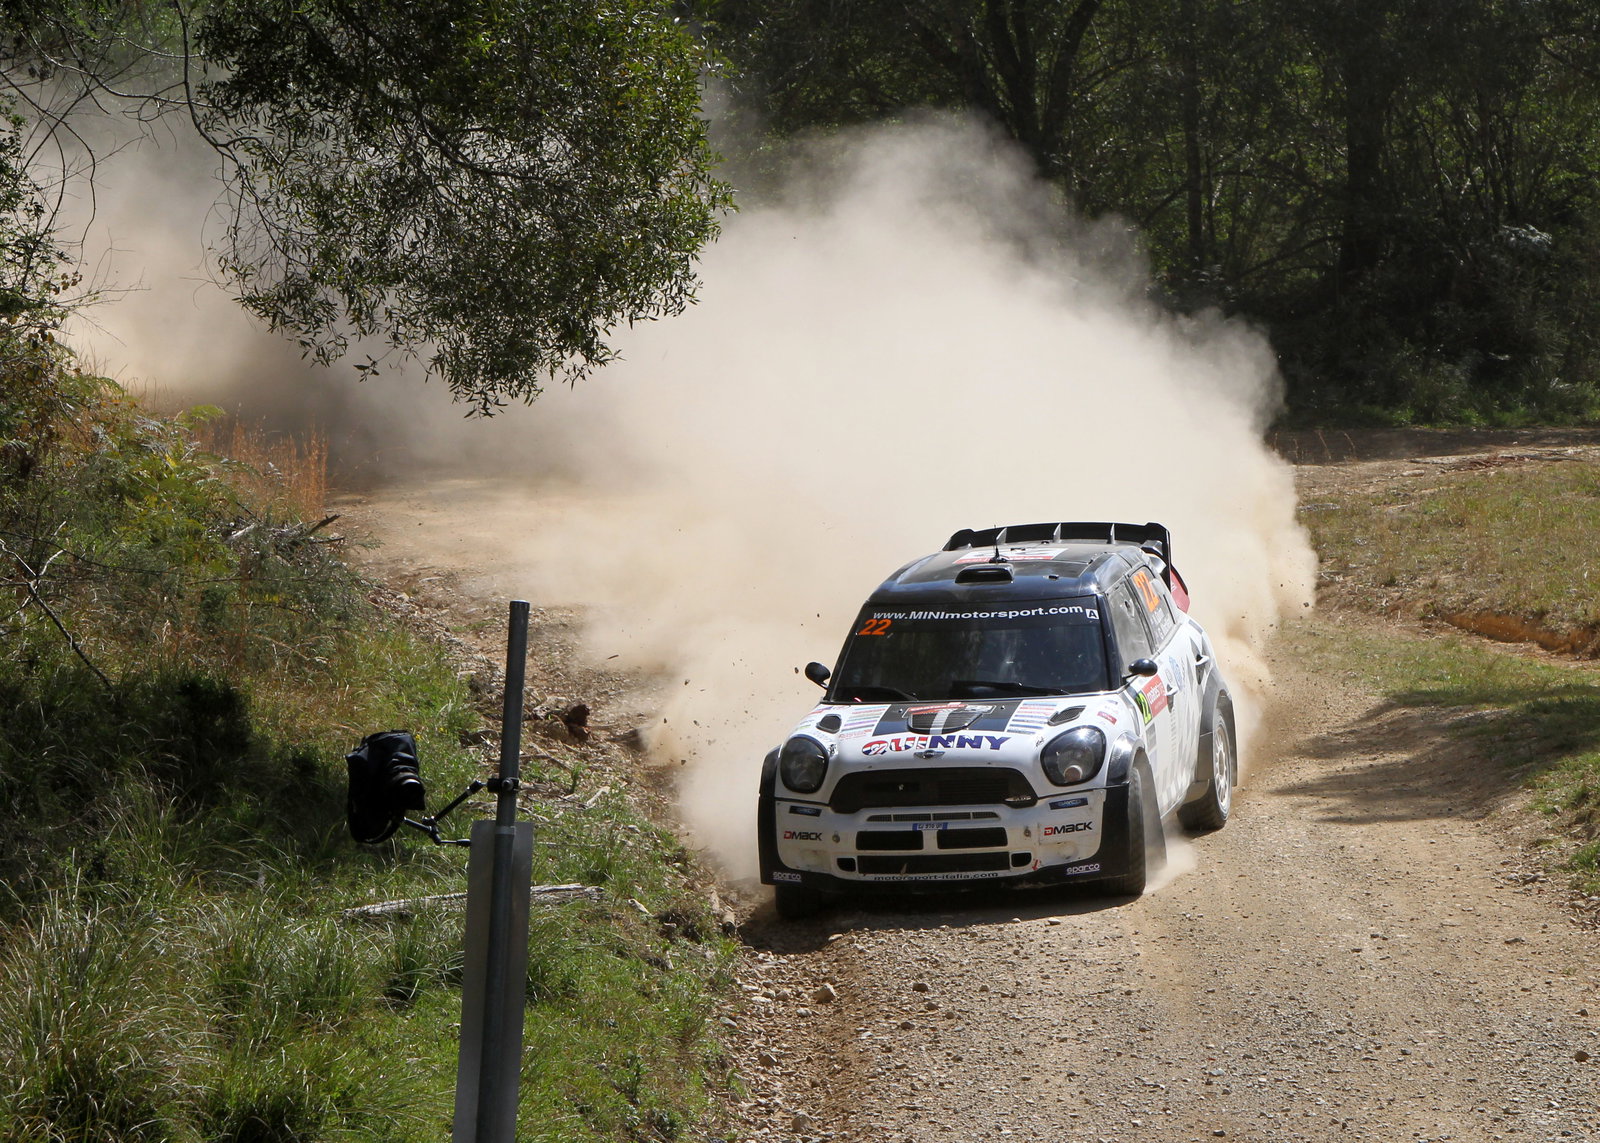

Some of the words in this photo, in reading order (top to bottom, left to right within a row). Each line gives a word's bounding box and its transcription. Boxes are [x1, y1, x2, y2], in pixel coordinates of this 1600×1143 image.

[1131, 571, 1159, 613] 22
[873, 605, 1083, 620] www.MINImotorsport.com
[859, 619, 892, 636] 22
[862, 735, 1012, 756] QUINNY
[874, 872, 998, 881] motorsport-italia.com
